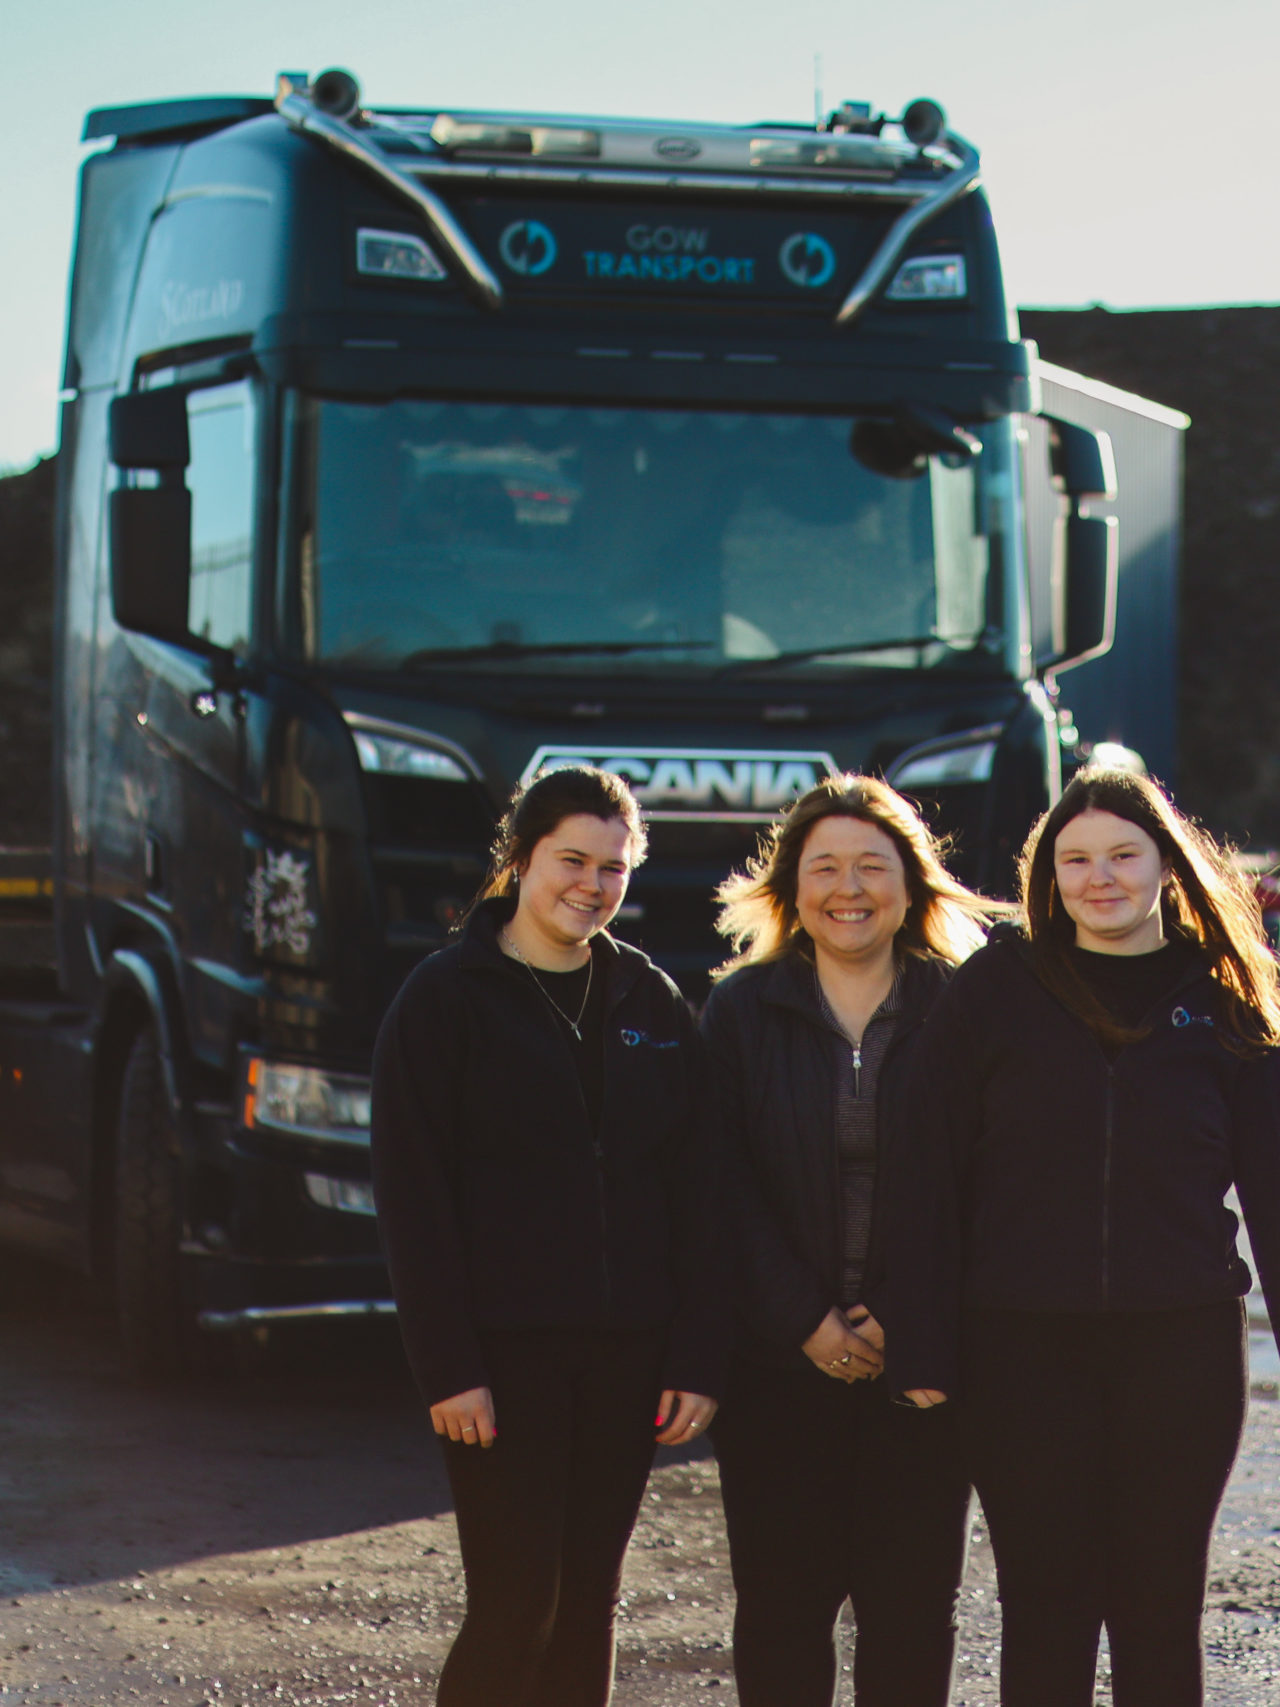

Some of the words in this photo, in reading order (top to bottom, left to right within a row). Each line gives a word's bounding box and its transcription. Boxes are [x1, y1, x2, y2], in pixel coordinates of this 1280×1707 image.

[626, 224, 709, 251] GOW
[584, 251, 756, 283] TRANSPORT
[543, 757, 817, 807] CANIA
